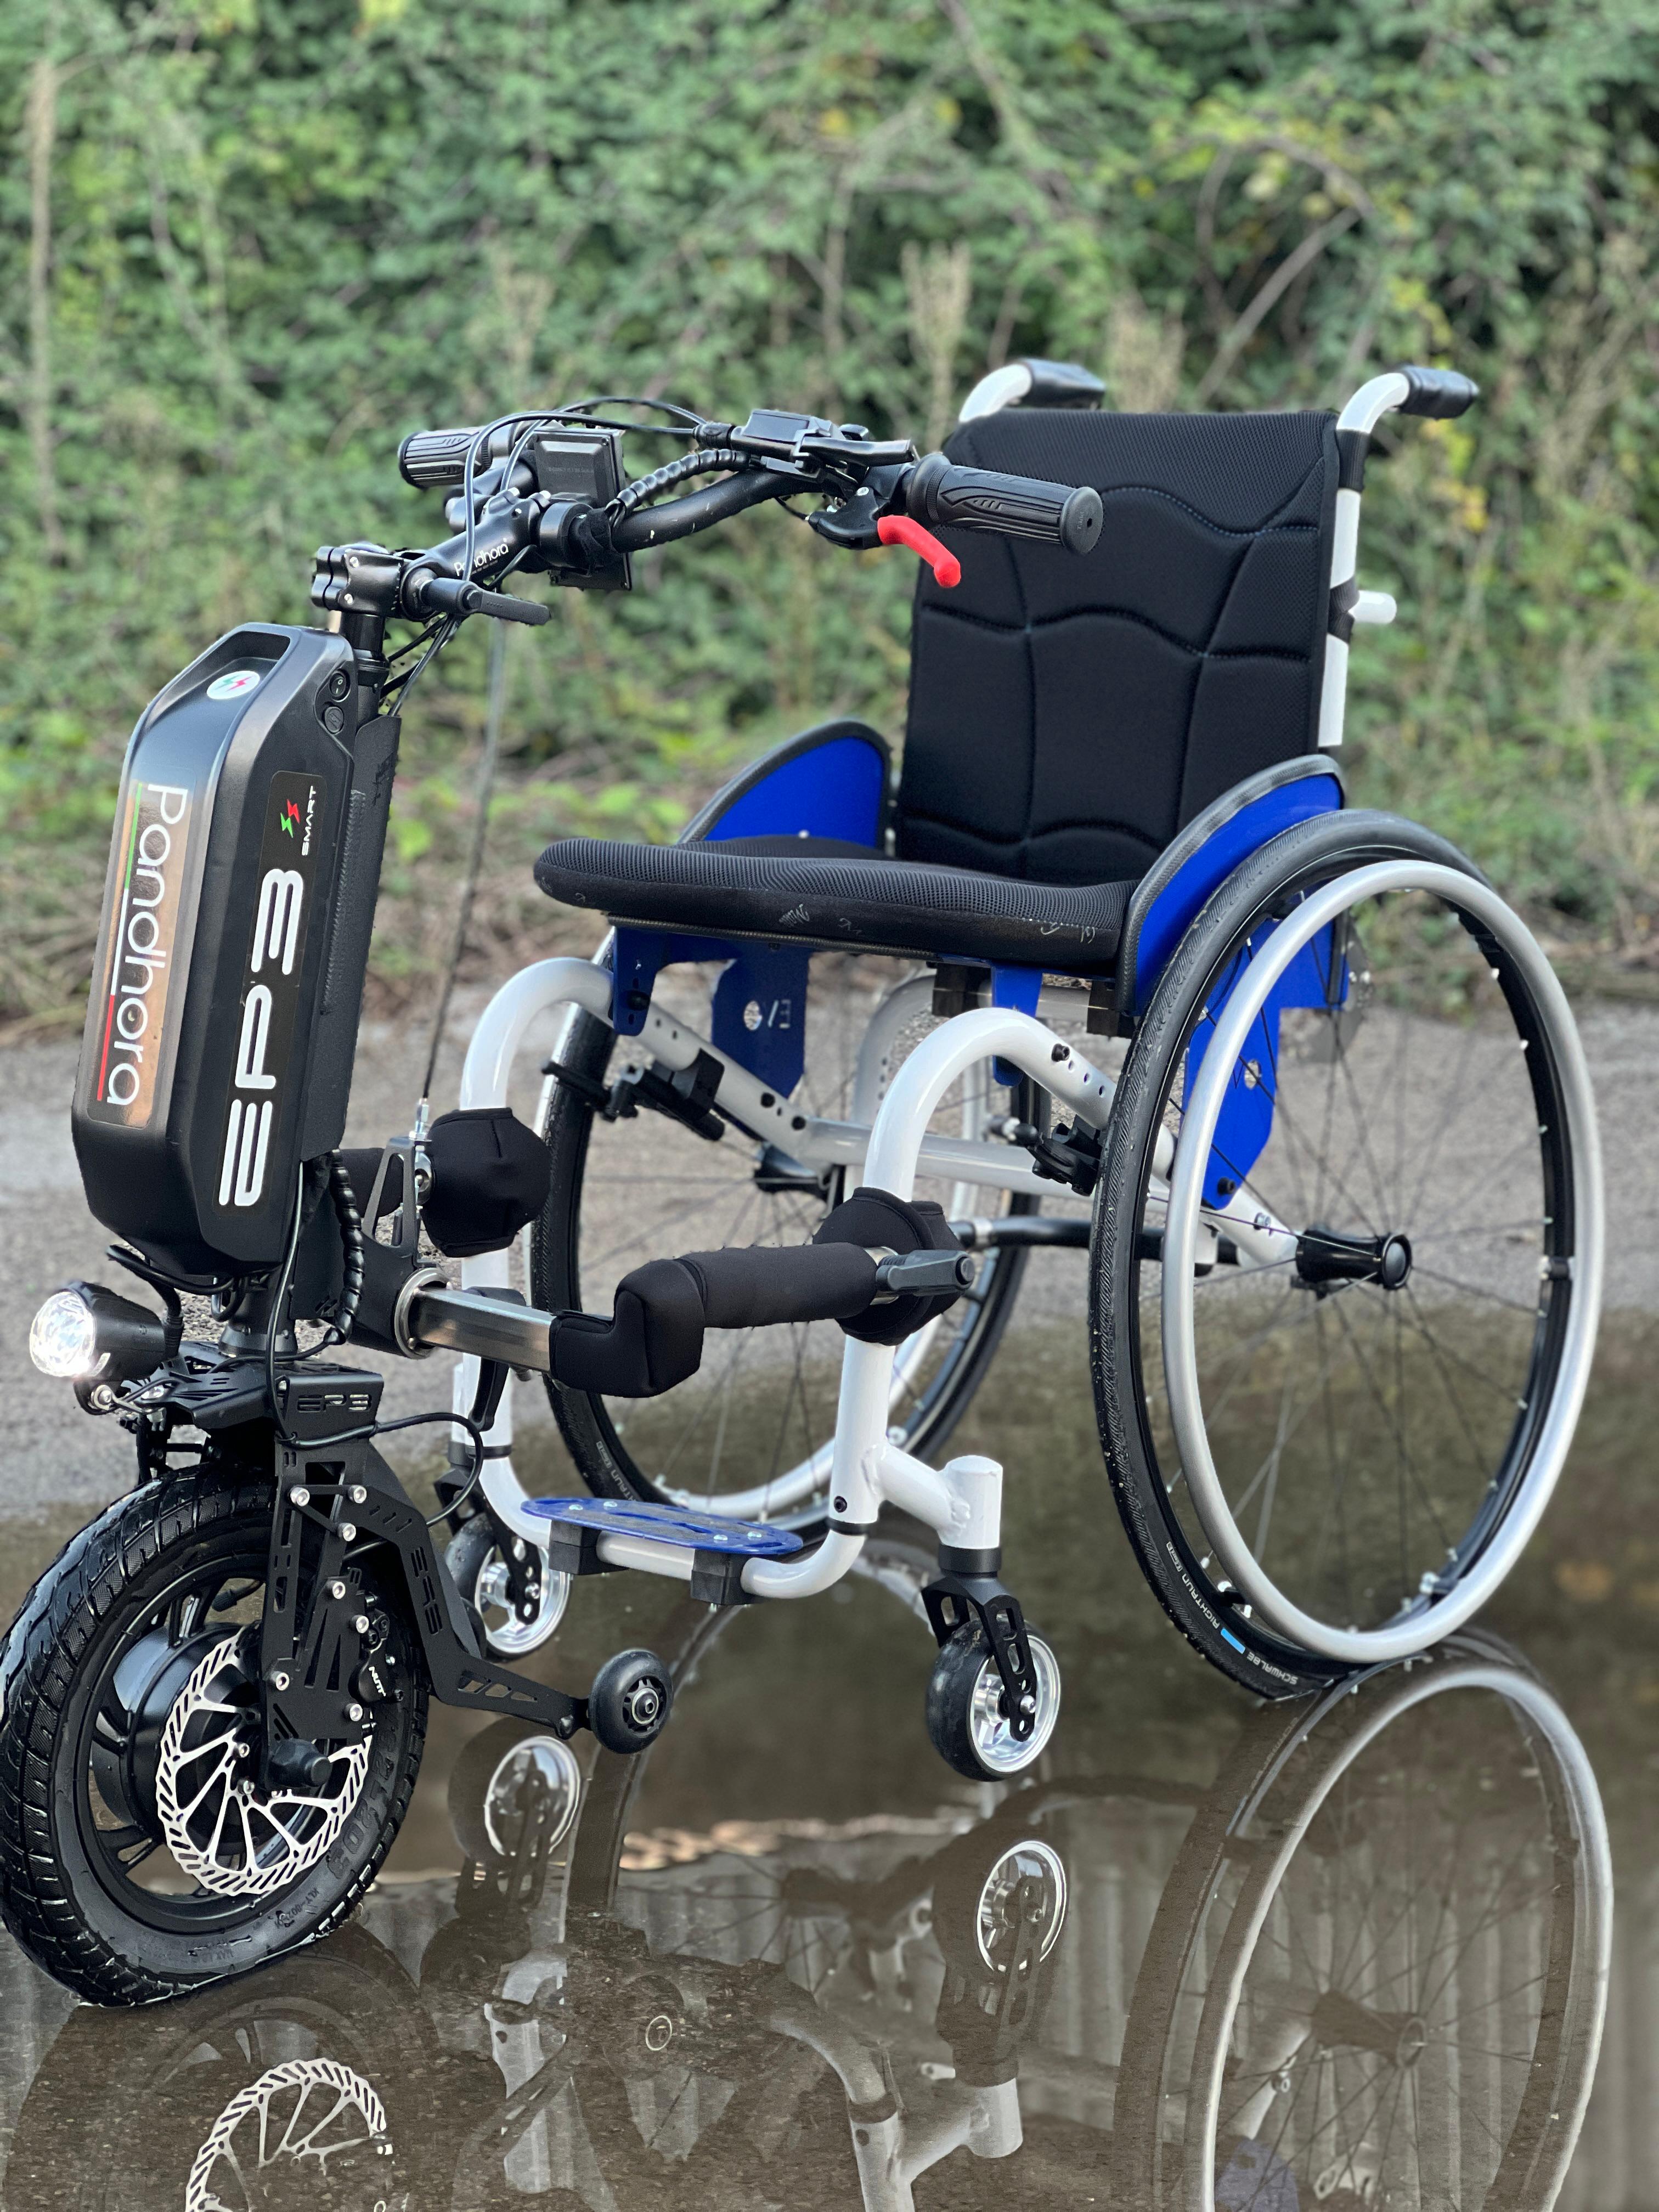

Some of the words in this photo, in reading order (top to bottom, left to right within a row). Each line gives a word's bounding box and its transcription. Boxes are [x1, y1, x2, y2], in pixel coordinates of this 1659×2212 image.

[302, 785, 317, 856] SMART
[107, 783, 189, 1106] Pandhora
[218, 868, 305, 1206] EP3
[297, 1393, 373, 1413] EP3
[1181, 1573, 1220, 1629] RIGHTRUN
[1246, 1651, 1299, 1686] SCHWALBE
